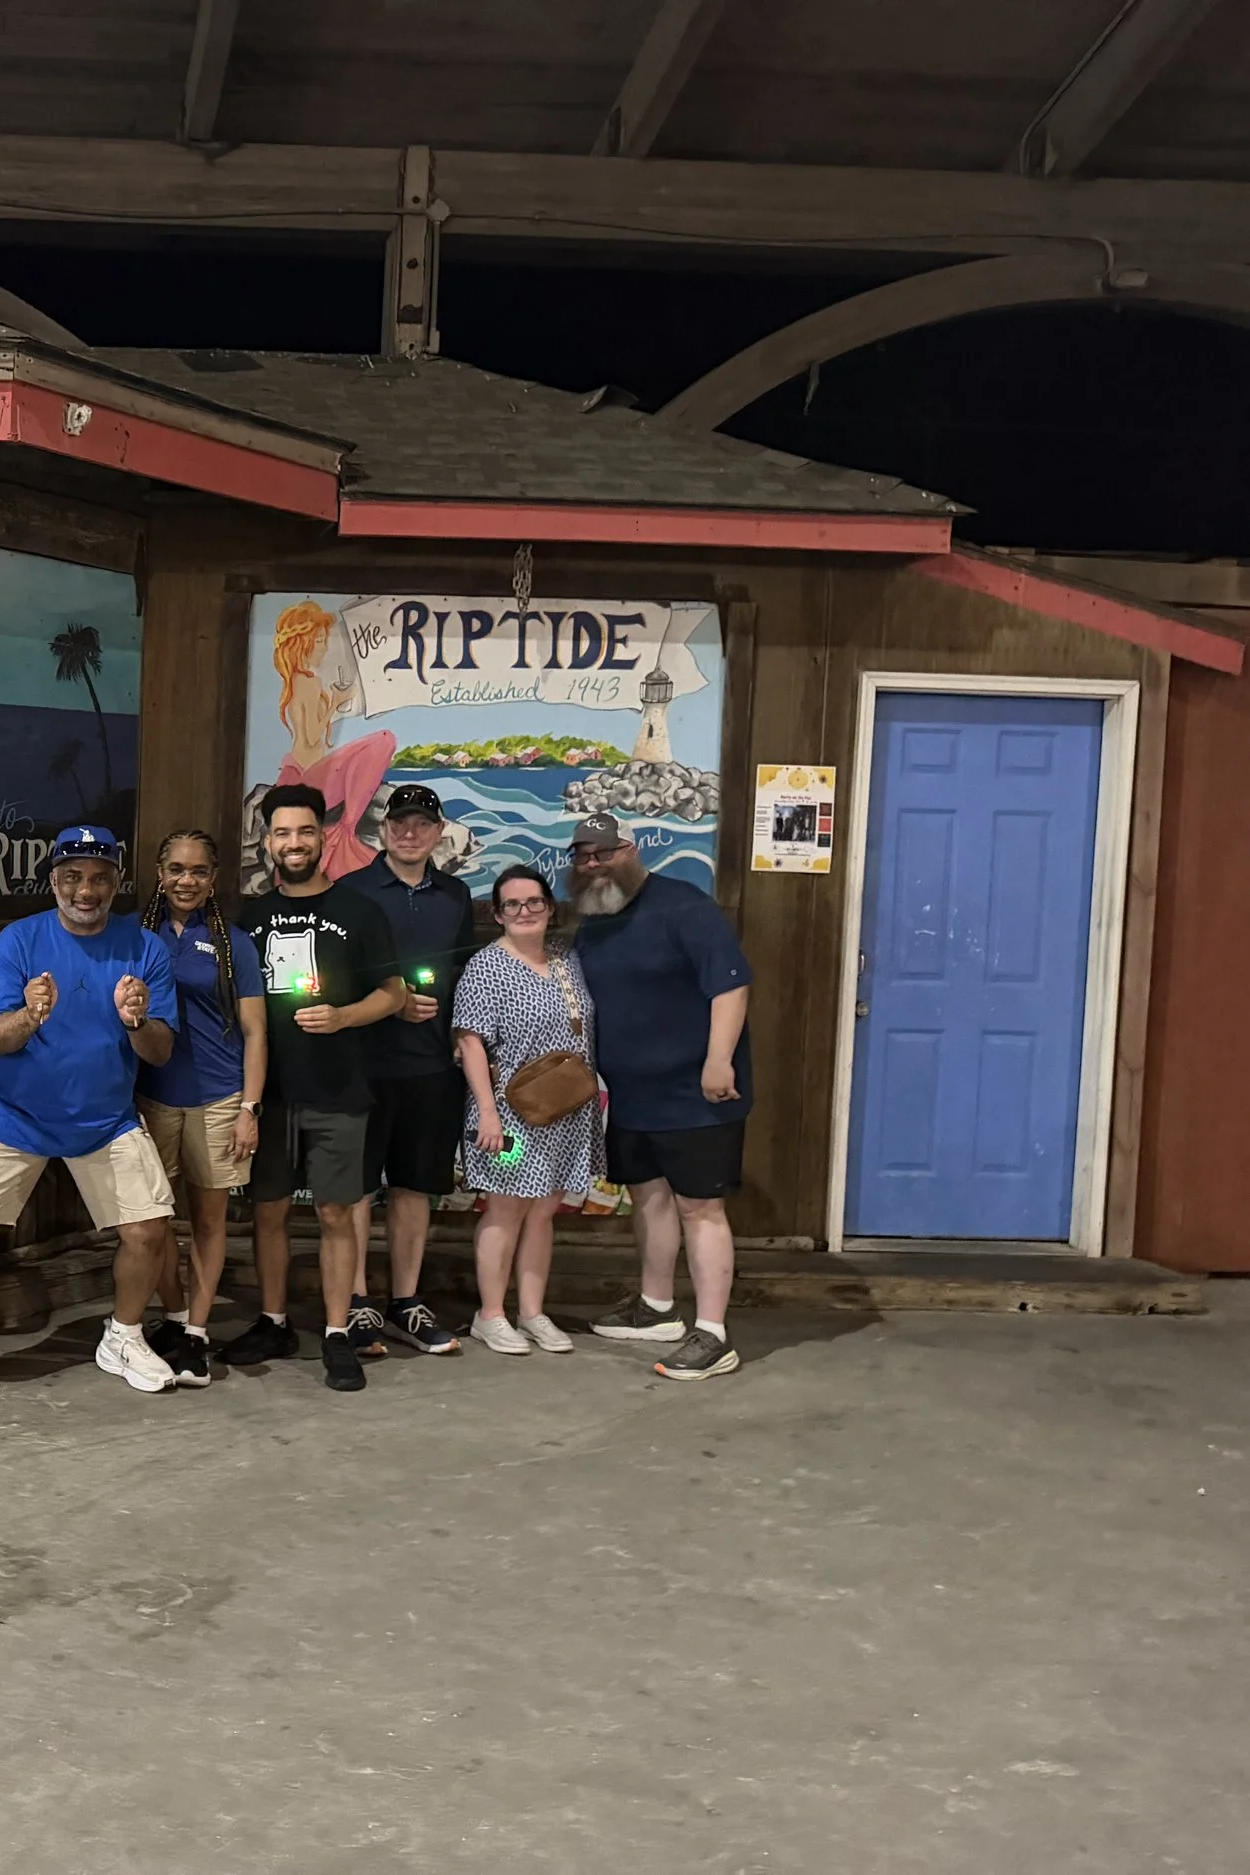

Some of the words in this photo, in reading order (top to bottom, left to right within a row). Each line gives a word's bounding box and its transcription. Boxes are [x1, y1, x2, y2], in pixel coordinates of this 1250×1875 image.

[351, 621, 387, 659] the
[384, 601, 646, 685] RIPTIDE
[431, 676, 546, 705] Established
[566, 676, 620, 701] 1943
[586, 818, 607, 831] GC
[270, 912, 317, 927] thank
[319, 919, 347, 940] you.
